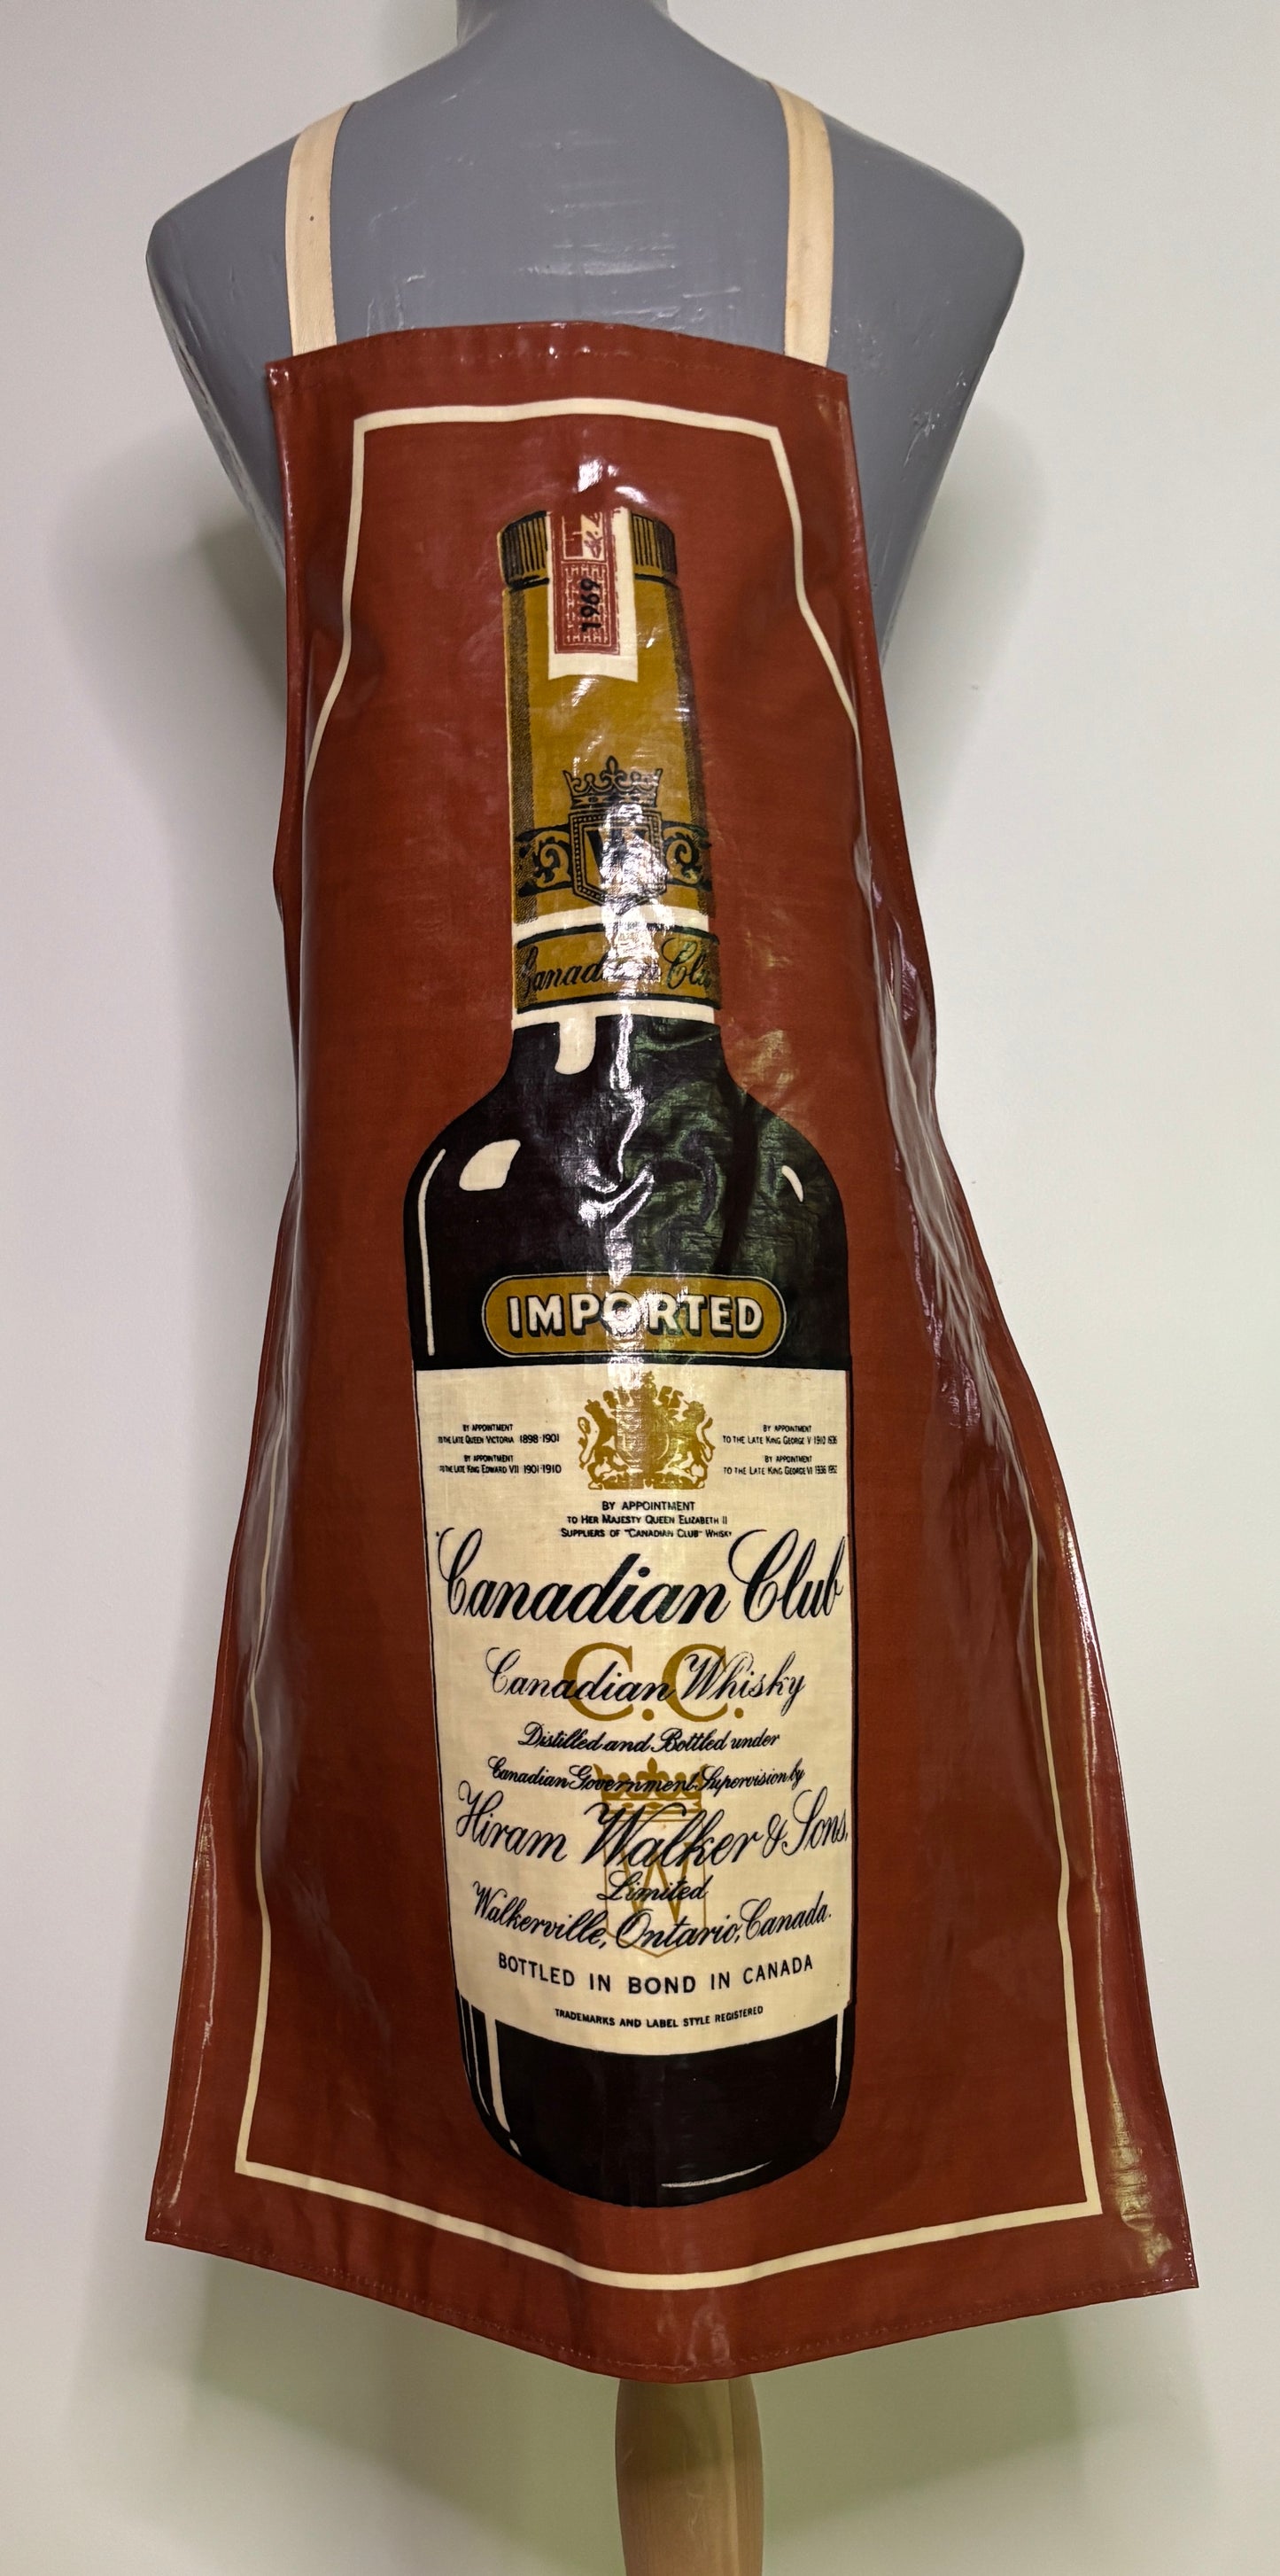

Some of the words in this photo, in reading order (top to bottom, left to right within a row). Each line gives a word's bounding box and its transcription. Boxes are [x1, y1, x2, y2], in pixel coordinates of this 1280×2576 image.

[580, 577, 602, 632] 1969
[508, 1290, 765, 1339] IMPORTED
[471, 1423, 514, 1432] APPOINTMENT
[763, 1424, 771, 1433] BY
[465, 1435, 485, 1444] QUEEN
[485, 1436, 515, 1444] VICTORIA
[723, 1435, 732, 1444] TO
[733, 1436, 745, 1444] THE
[748, 1436, 764, 1444] LATE
[765, 1436, 781, 1444] KING
[783, 1435, 804, 1444] GEORGE
[467, 1465, 480, 1474] KING
[481, 1464, 508, 1474] EDWARD
[508, 1465, 519, 1474] VII
[784, 1466, 806, 1475] GEORGE
[601, 1501, 616, 1511] BY
[621, 1501, 695, 1511] APPOINTMENT
[581, 1515, 599, 1524] HER
[601, 1515, 641, 1524] MAJESTY
[645, 1514, 675, 1525] QUEEN
[679, 1514, 719, 1525] ELIZABETH
[561, 1528, 605, 1537] SUPPLIERS
[609, 1529, 621, 1537] OF
[705, 1529, 732, 1537] WHISKY
[485, 1646, 676, 1702] Canadian
[684, 1650, 806, 1716] Whisky
[517, 1721, 603, 1749] Distilled
[602, 1732, 651, 1753] and
[650, 1727, 732, 1753] Bottled
[731, 1727, 780, 1749] under
[487, 1755, 569, 1789] Canadian
[787, 1757, 805, 1791] by
[456, 1779, 568, 1862] Hiram
[581, 1802, 764, 1868] Walker
[762, 1813, 788, 1858] &
[781, 1786, 848, 1856] Sons,
[596, 1870, 714, 1902] Limited
[472, 1880, 608, 1950] Walkerville,
[616, 1908, 742, 1949] Ontario,
[739, 1890, 832, 1940] Canada.
[499, 1951, 576, 1987] BOTTLED
[589, 1973, 611, 1993] IN
[628, 1975, 696, 1995] BOND
[710, 1971, 731, 1990] IN
[743, 1954, 813, 1985] CANADA
[555, 2008, 616, 2026] TRADEMARKS
[619, 2018, 642, 2028] AND
[647, 2019, 679, 2028] LABEL
[683, 2015, 710, 2027] STYLE
[714, 2005, 764, 2023] REGISTERED
